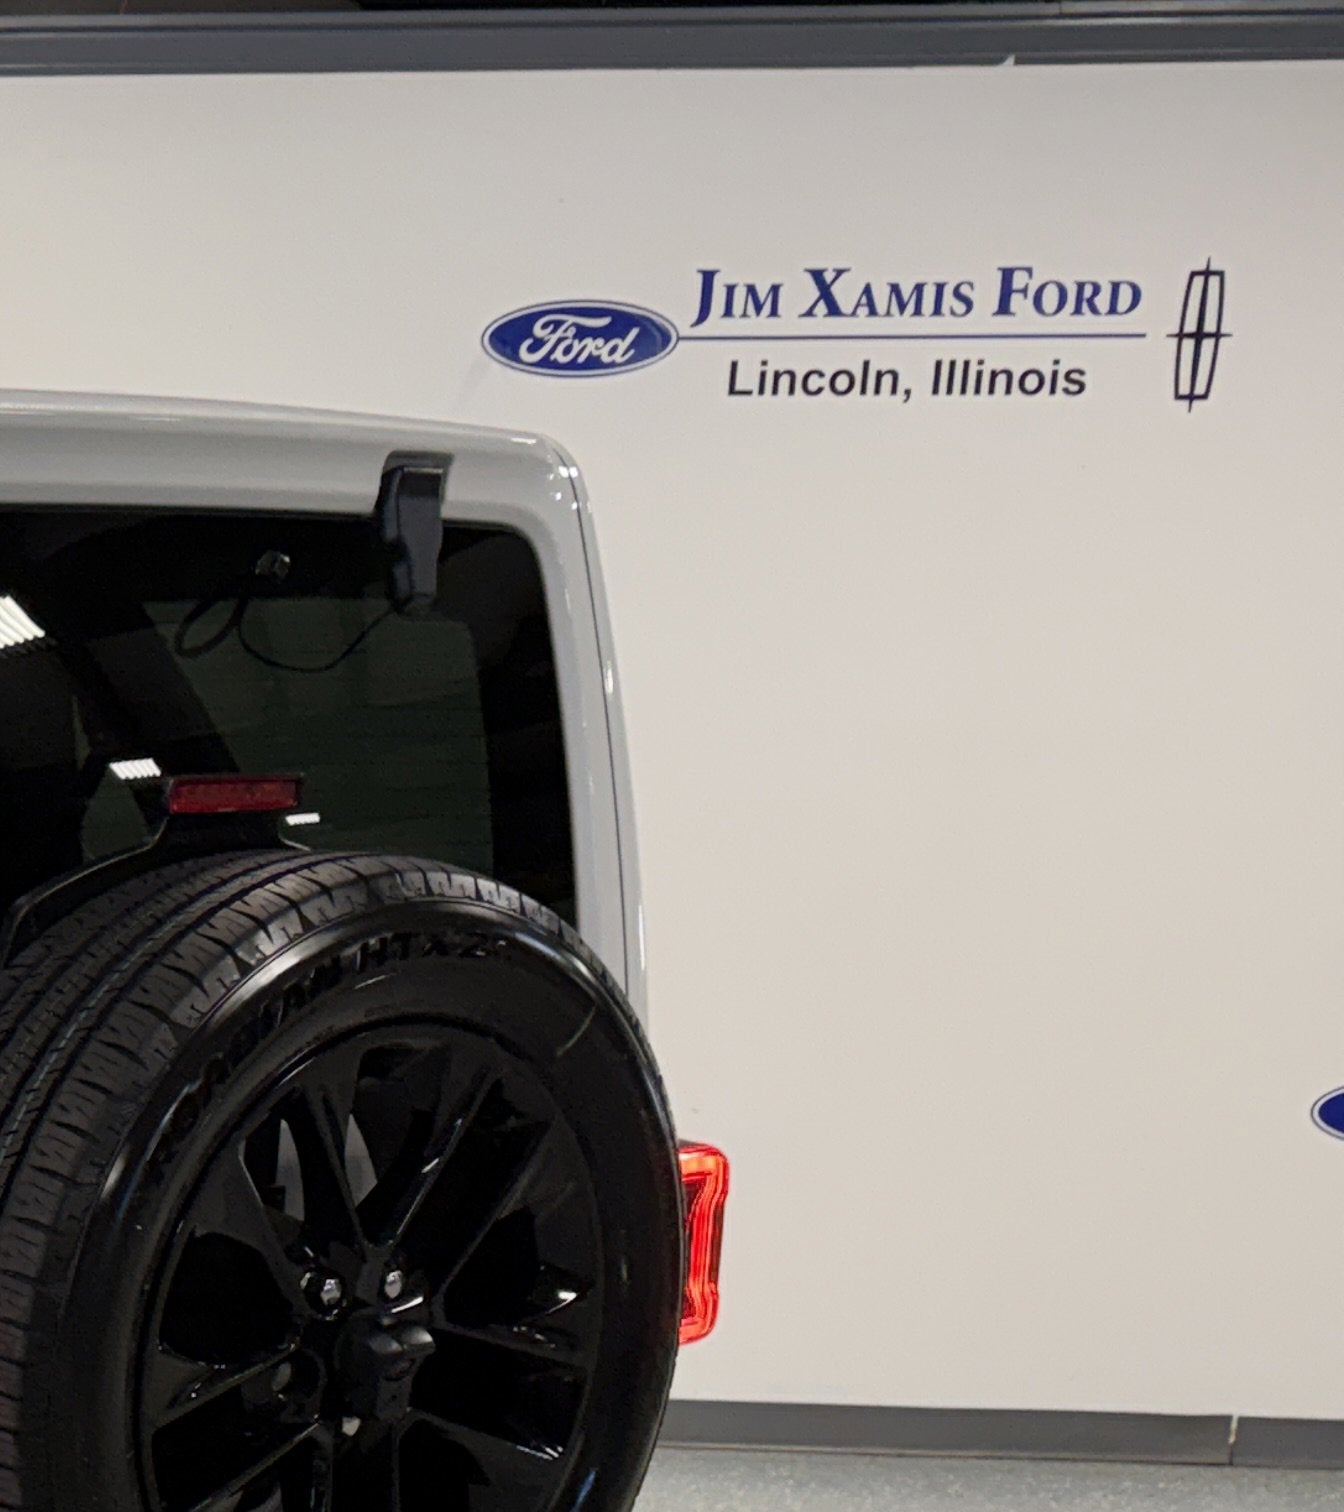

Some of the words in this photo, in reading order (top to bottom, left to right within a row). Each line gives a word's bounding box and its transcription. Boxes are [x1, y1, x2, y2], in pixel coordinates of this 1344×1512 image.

[798, 268, 975, 319] XAMIS
[993, 267, 1142, 318] FORD
[519, 314, 635, 366] Ford
[728, 360, 913, 402] Lincoln,
[931, 360, 1087, 397] Illinois
